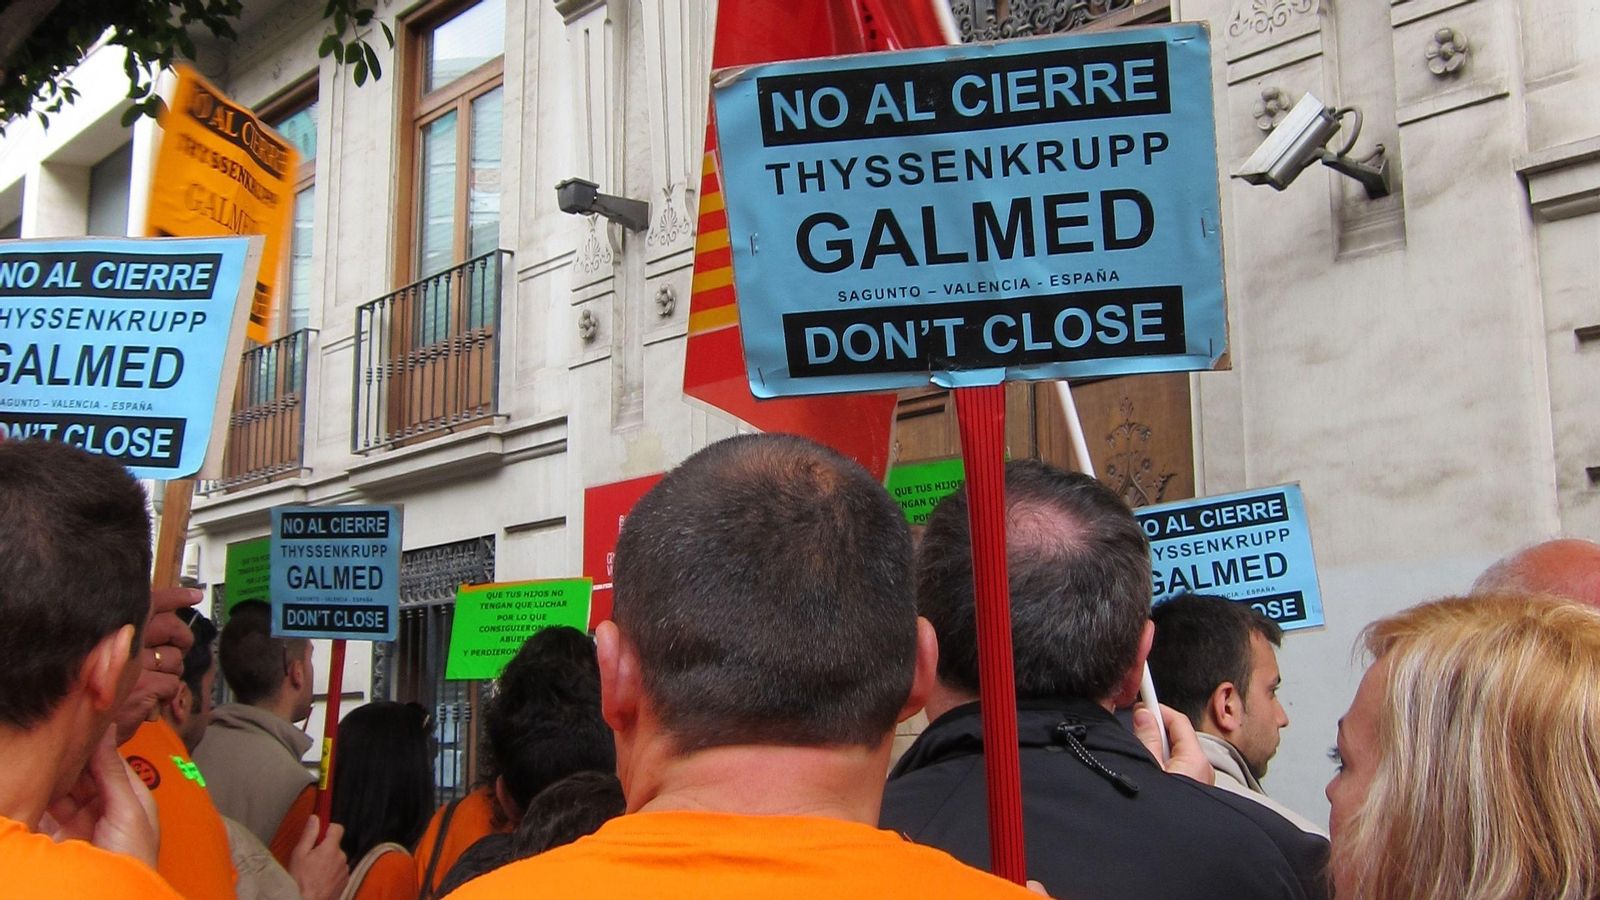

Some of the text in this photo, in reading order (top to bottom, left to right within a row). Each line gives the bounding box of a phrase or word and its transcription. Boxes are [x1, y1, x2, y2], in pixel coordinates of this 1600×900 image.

[771, 57, 1158, 132] NO AL CIERRE
[765, 131, 1170, 196] THYSSENKRUPP
[795, 187, 1155, 274] GALMED
[0, 261, 214, 291] NO AL CIERRE
[837, 285, 921, 303] SAGUNTO
[943, 278, 1031, 296] VALENCIA
[1050, 268, 1120, 287] ESPAÑA
[0, 308, 207, 333] HYSSENKRUPP
[804, 302, 1166, 365] DON'T CLOSE
[51, 399, 100, 410] VALENCIA
[111, 399, 153, 412] ESPAÑA
[63, 425, 174, 458] CLOSE
[894, 487, 912, 498] QUE
[915, 484, 932, 493] TUS
[283, 517, 387, 534] NO AL CIERRE
[1165, 514, 1195, 534] AL
[1200, 499, 1283, 528] CIERRE
[281, 545, 387, 558] THYSSENKRUPP
[287, 565, 383, 590] GALMED
[486, 589, 564, 600] QUE TUS HIJOS NO
[1246, 586, 1276, 595] ESPAÑA
[480, 600, 567, 610] TENGAN QUE LUCHAR
[496, 613, 547, 622] POR LO QUE
[287, 610, 384, 628] DON'T CLOSE
